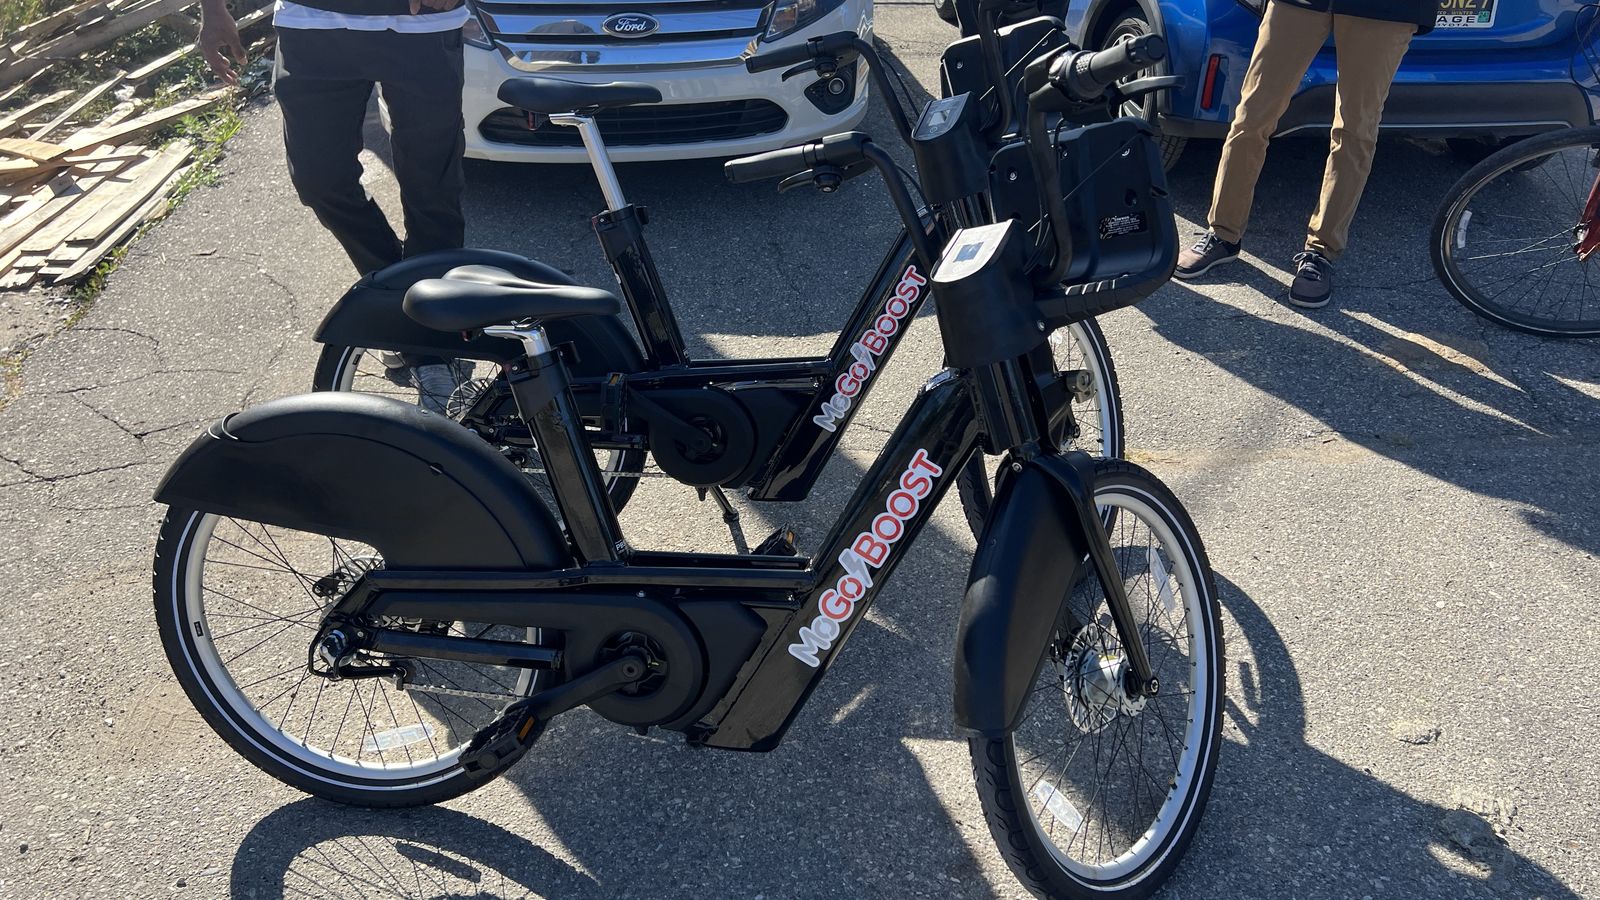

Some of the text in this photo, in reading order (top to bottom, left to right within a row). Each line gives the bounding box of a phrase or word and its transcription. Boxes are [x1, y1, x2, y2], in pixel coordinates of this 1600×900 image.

[615, 17, 647, 31] Ford
[860, 265, 927, 356] BOOST
[851, 448, 943, 568] BOOST
